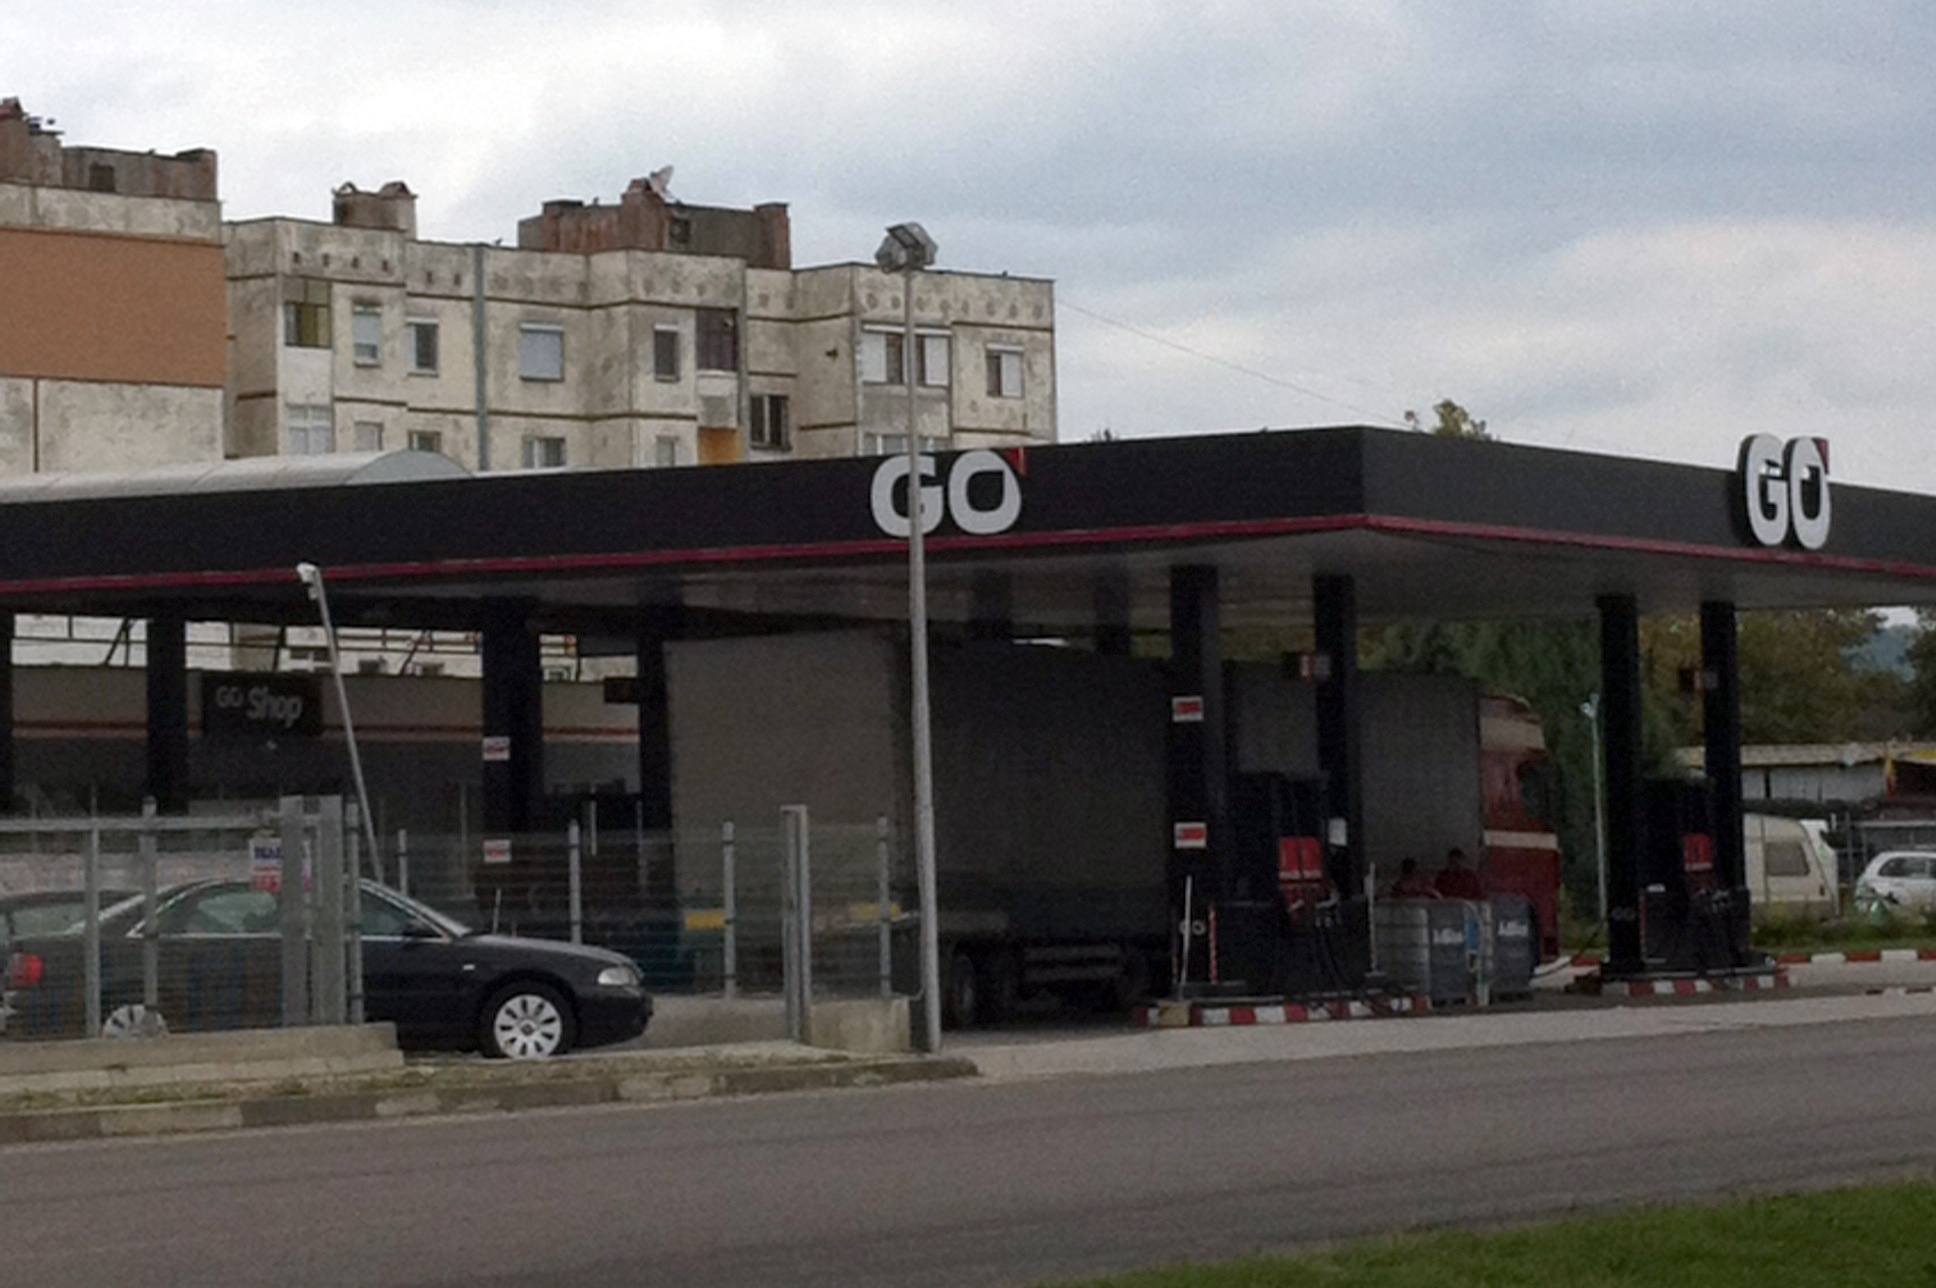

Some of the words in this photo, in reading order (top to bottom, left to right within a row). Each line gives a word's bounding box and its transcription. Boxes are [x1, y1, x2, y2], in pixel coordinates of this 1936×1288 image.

[871, 450, 1022, 538] GO
[1744, 432, 1831, 549] GO
[216, 686, 243, 708] GO
[246, 685, 303, 728] Shop
